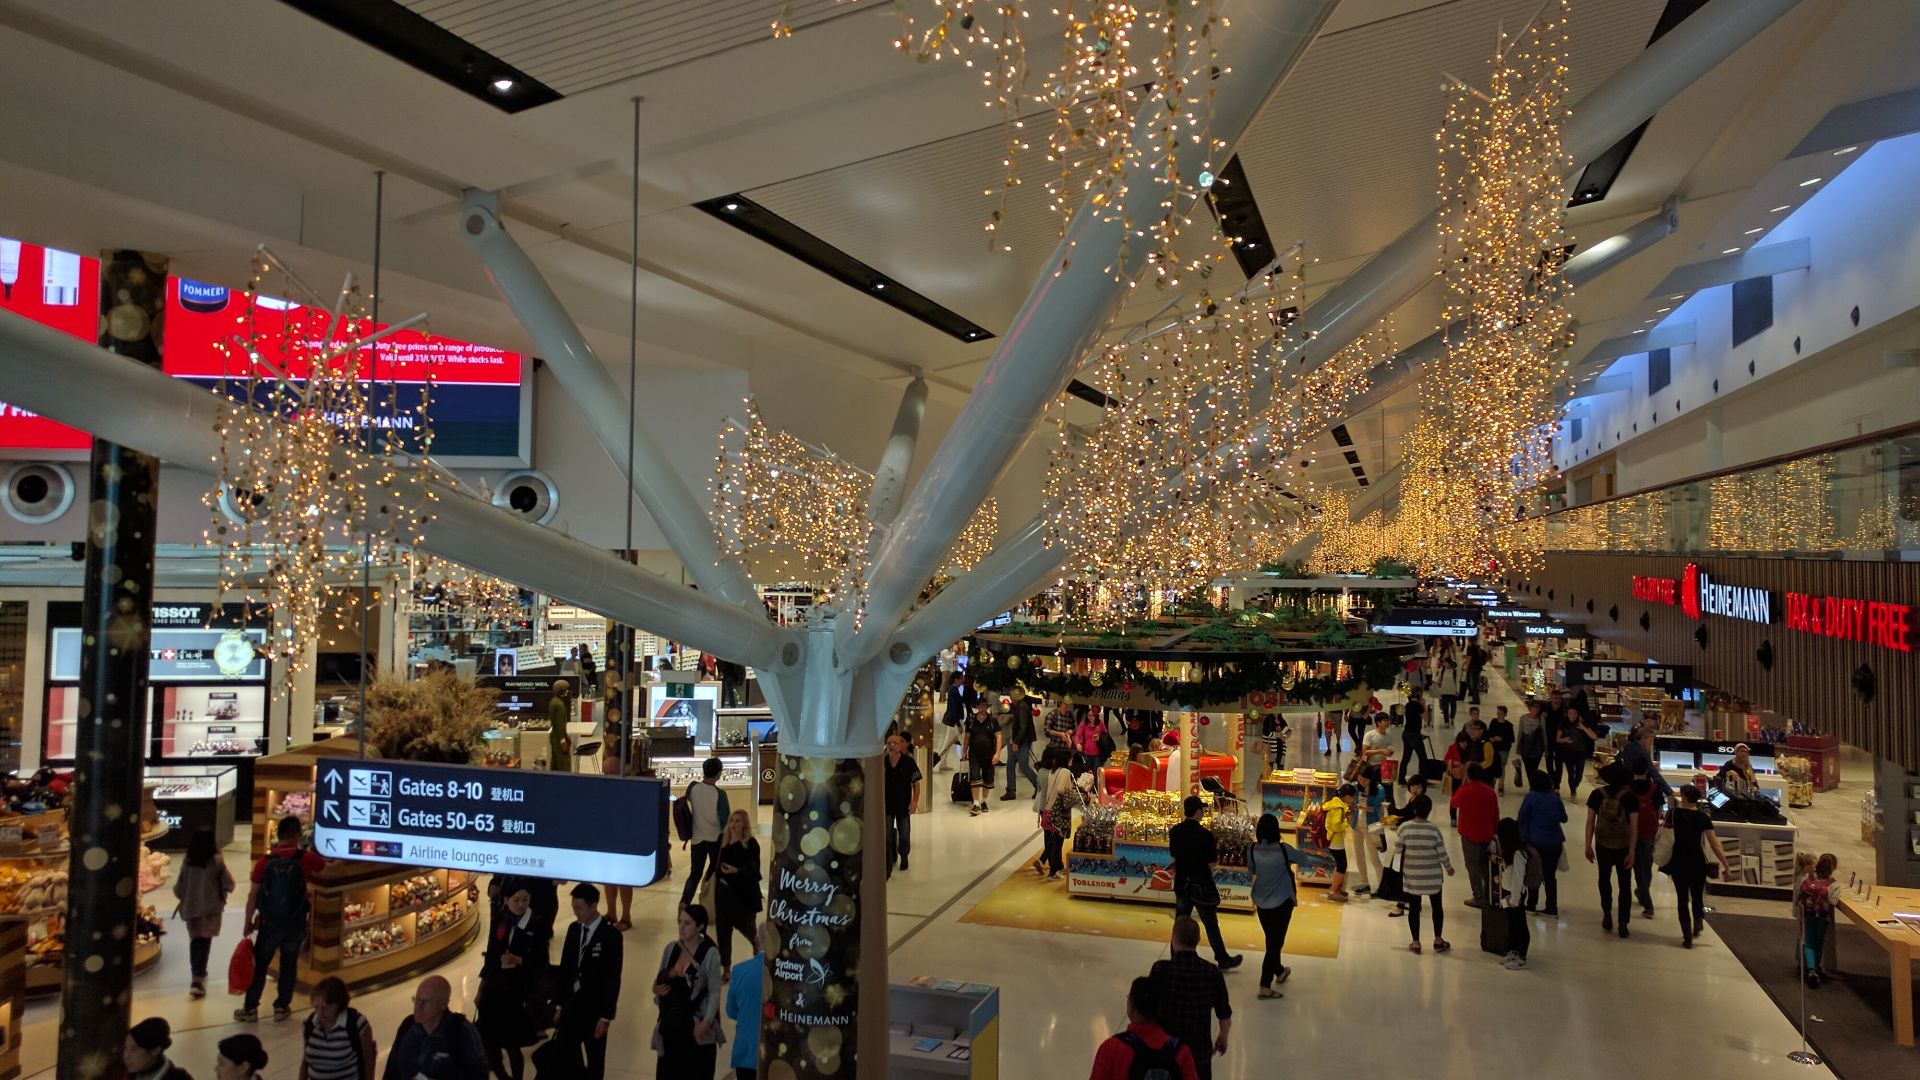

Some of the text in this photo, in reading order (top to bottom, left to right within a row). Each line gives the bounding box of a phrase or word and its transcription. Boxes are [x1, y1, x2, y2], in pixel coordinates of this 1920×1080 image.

[407, 342, 428, 353] prices
[445, 344, 464, 354] range
[465, 343, 473, 352] of
[447, 355, 467, 363] While
[468, 355, 489, 364] stocks
[490, 356, 505, 364] last.
[1700, 572, 1770, 624] HEINEMANN
[1526, 626, 1564, 634] LOCAL FOOD
[1785, 591, 1911, 654] TAX & DUTY FREE
[1583, 666, 1617, 682] JB
[399, 777, 483, 800] Gates 8-10
[491, 787, 524, 802] 登机口
[398, 808, 495, 832] Gates 50-63
[502, 819, 535, 835] 登机口
[410, 845, 499, 867] Airline lounges
[505, 855, 546, 869] 航空休息室
[780, 867, 839, 906] Merry
[769, 899, 851, 928] Christmas
[789, 933, 813, 950] from
[775, 957, 805, 972] Sydney
[774, 967, 804, 982] Airport
[795, 992, 804, 1008] &
[780, 1008, 849, 1025] HEINEMANN
